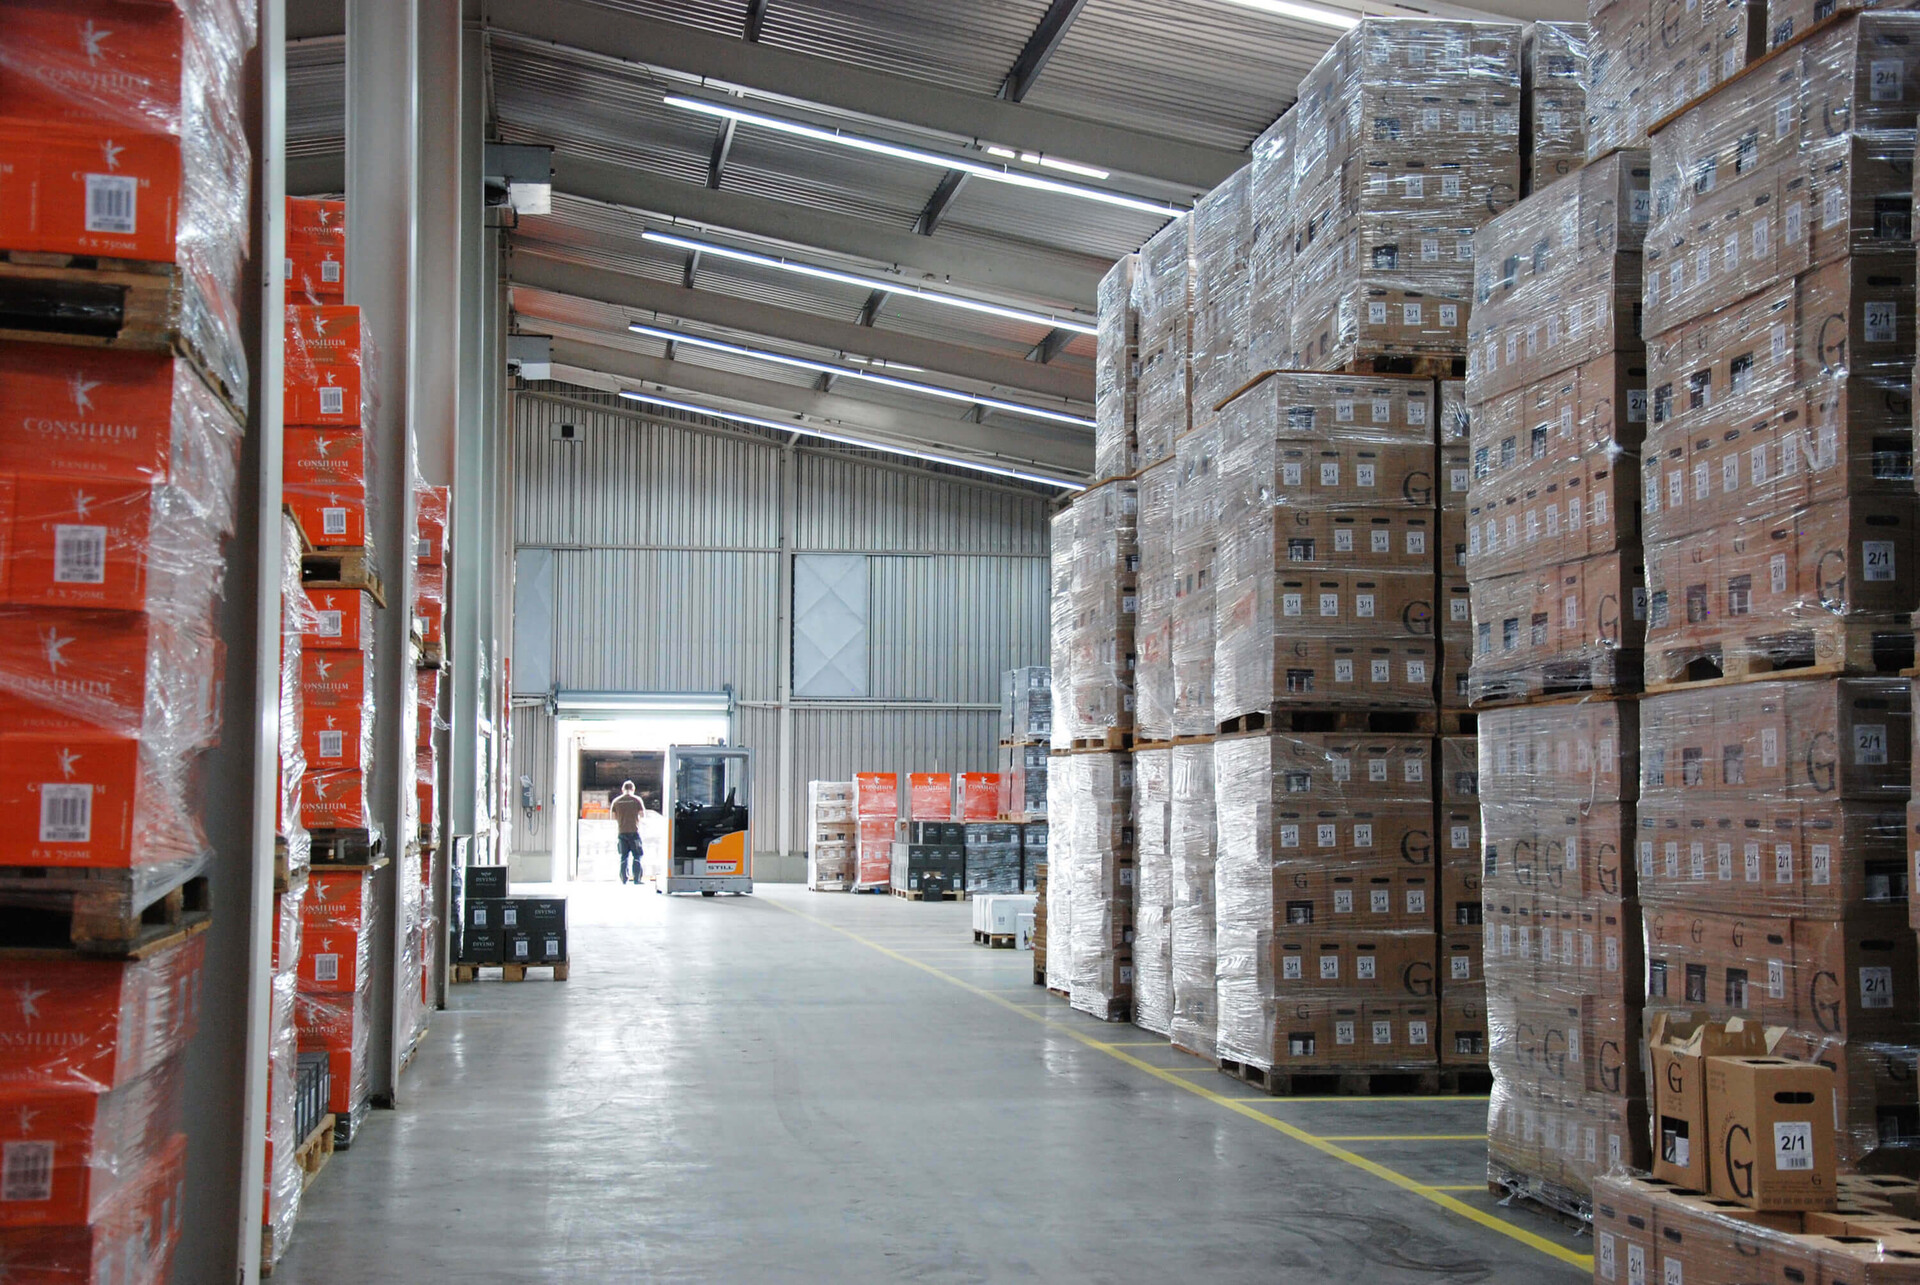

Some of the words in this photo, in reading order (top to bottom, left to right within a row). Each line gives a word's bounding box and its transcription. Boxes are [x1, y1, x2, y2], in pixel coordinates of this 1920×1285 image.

[1876, 72, 1897, 85] 2/1
[1556, 160, 1569, 173] G
[1788, 212, 1799, 227] 2/1
[1372, 308, 1384, 316] 3/1
[1406, 309, 1418, 317] 3/1
[1442, 311, 1454, 319] 3/1
[1869, 312, 1891, 326] 2/1
[1817, 312, 1847, 375] G
[1339, 405, 1351, 413] 3/1
[1375, 406, 1387, 414] 3/1
[24, 418, 138, 440] CONSILIUM
[298, 460, 349, 468] CONSILIUM
[1753, 455, 1764, 469] 2/1
[1287, 469, 1299, 477] 3/1
[1323, 469, 1336, 477] 3/1
[1359, 470, 1372, 478] 3/1
[1725, 464, 1736, 478] 2/1
[1453, 475, 1466, 483] 3/1
[1403, 471, 1432, 505] G
[1296, 511, 1309, 526] G
[1338, 535, 1350, 543] 3/1
[1374, 536, 1387, 544] 3/1
[1409, 537, 1422, 545] 3/1
[1868, 551, 1889, 566] 2/1
[1773, 565, 1783, 578] 2/1
[1816, 548, 1846, 615] G
[1286, 600, 1299, 608] 3/1
[1323, 600, 1336, 608] 3/1
[1359, 601, 1372, 609] 3/1
[1453, 605, 1466, 613] 3/1
[1403, 601, 1432, 634] G
[1598, 594, 1620, 647] G
[1295, 641, 1308, 657] G
[1337, 666, 1350, 674] 3/1
[1374, 666, 1387, 674] 3/1
[1410, 667, 1422, 675] 3/1
[303, 682, 349, 690] ONSILIUM
[1859, 735, 1881, 749] 2/1
[1807, 731, 1836, 793] G
[1371, 765, 1384, 773] 3/1
[1407, 766, 1420, 774] 3/1
[301, 803, 347, 811] ONSILIUM
[1320, 831, 1333, 839] 3/1
[1357, 830, 1369, 839] 3/1
[1454, 832, 1467, 841] 3/1
[1401, 830, 1430, 865] G
[1514, 840, 1531, 885] G
[1667, 852, 1676, 863] 2/1
[1720, 854, 1729, 865] 2/1
[1778, 856, 1789, 868] 2/1
[1814, 856, 1827, 868] 2/1
[1546, 840, 1563, 889] G
[1598, 843, 1618, 895] G
[1294, 873, 1308, 889] G
[1464, 873, 1478, 890] G
[1337, 896, 1349, 904] 3/1
[1373, 896, 1386, 904] 3/1
[1409, 896, 1422, 905] 3/1
[1691, 919, 1703, 943] G
[1732, 921, 1744, 948] G
[1286, 962, 1298, 970] 3/1
[1323, 962, 1335, 971] 3/1
[1359, 962, 1372, 970] 3/1
[1454, 962, 1467, 970] 3/1
[1404, 962, 1433, 997] G
[1771, 970, 1781, 982] 2/1
[1865, 978, 1886, 992] 2/1
[1811, 970, 1841, 1033] G
[1296, 1004, 1310, 1020] G
[1463, 1002, 1477, 1019] G
[1338, 1027, 1351, 1036] 3/1
[1375, 1027, 1388, 1035] 3/1
[1411, 1027, 1424, 1036] 3/1
[1544, 1029, 1565, 1077] G
[1599, 1041, 1621, 1093] G
[1667, 1062, 1682, 1094] G
[1781, 1135, 1805, 1151] 2/1
[1725, 1124, 1754, 1199] G
[1811, 1173, 1822, 1186] G
[1603, 1245, 1612, 1260] 2/1
[1631, 1258, 1642, 1275] 2/1
